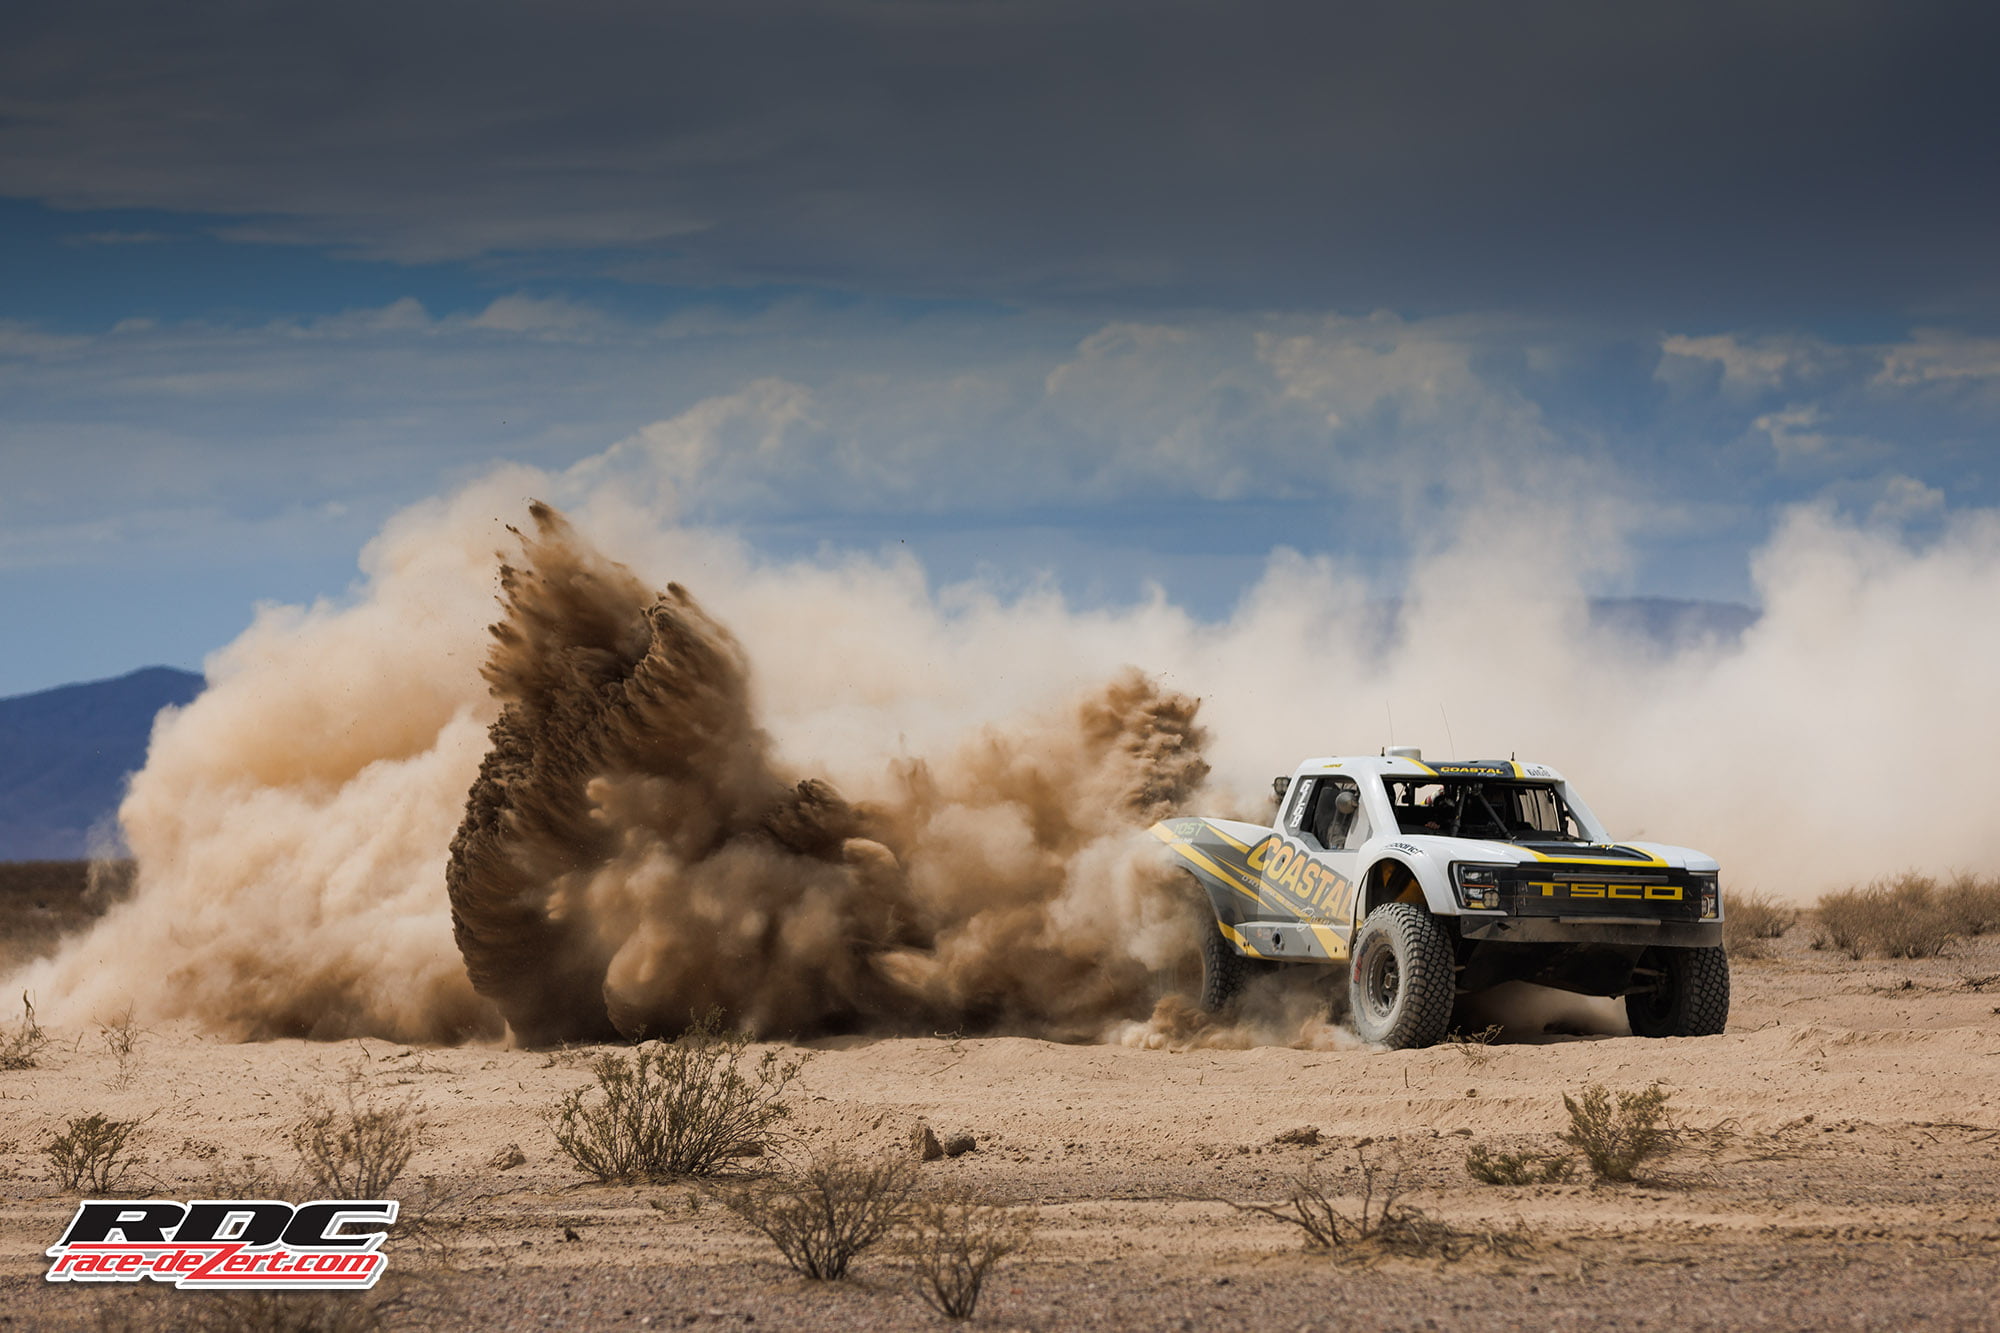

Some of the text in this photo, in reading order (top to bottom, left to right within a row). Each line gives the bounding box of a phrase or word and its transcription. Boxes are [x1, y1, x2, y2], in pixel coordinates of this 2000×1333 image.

[1440, 766, 1504, 775] COASTAL
[1246, 837, 1354, 919] COASTAL
[1528, 881, 1683, 900] TSCO
